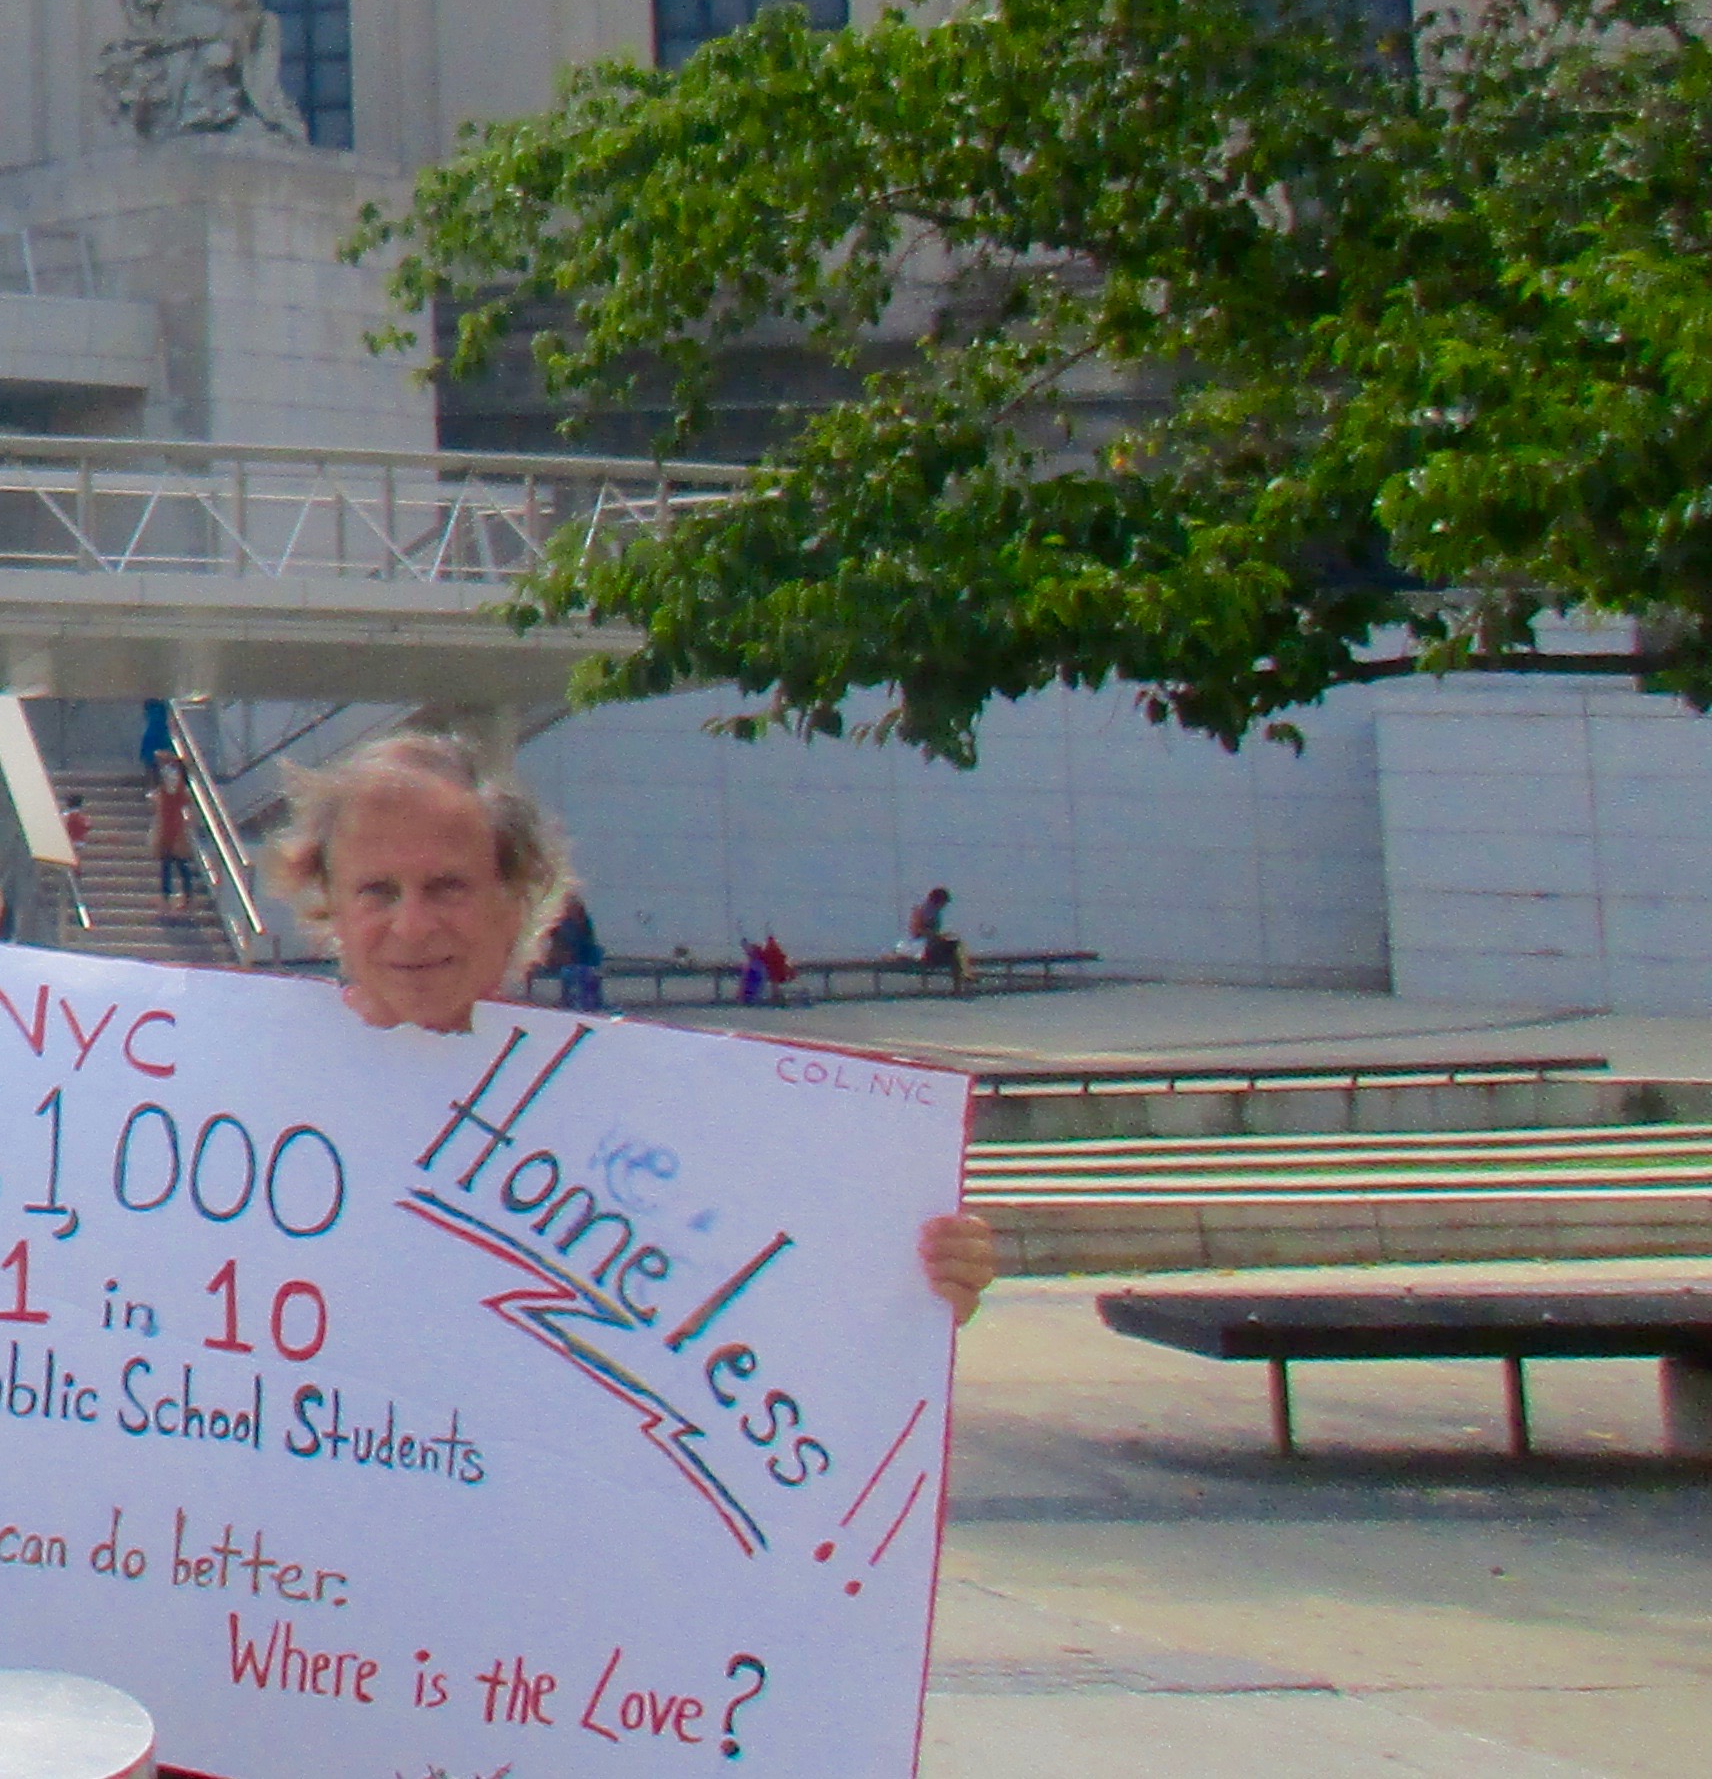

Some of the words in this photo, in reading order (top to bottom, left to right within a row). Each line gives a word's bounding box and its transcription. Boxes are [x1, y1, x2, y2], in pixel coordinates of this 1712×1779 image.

[102, 1277, 159, 1335] in
[204, 1258, 329, 1362] 10
[117, 1355, 264, 1450] School
[284, 1382, 487, 1486] Students
[89, 1505, 147, 1580] do
[172, 1506, 350, 1608] better.
[228, 1612, 378, 1705] Where
[413, 1648, 449, 1709] is
[476, 1655, 557, 1726] the
[579, 1646, 768, 1759] Love?
